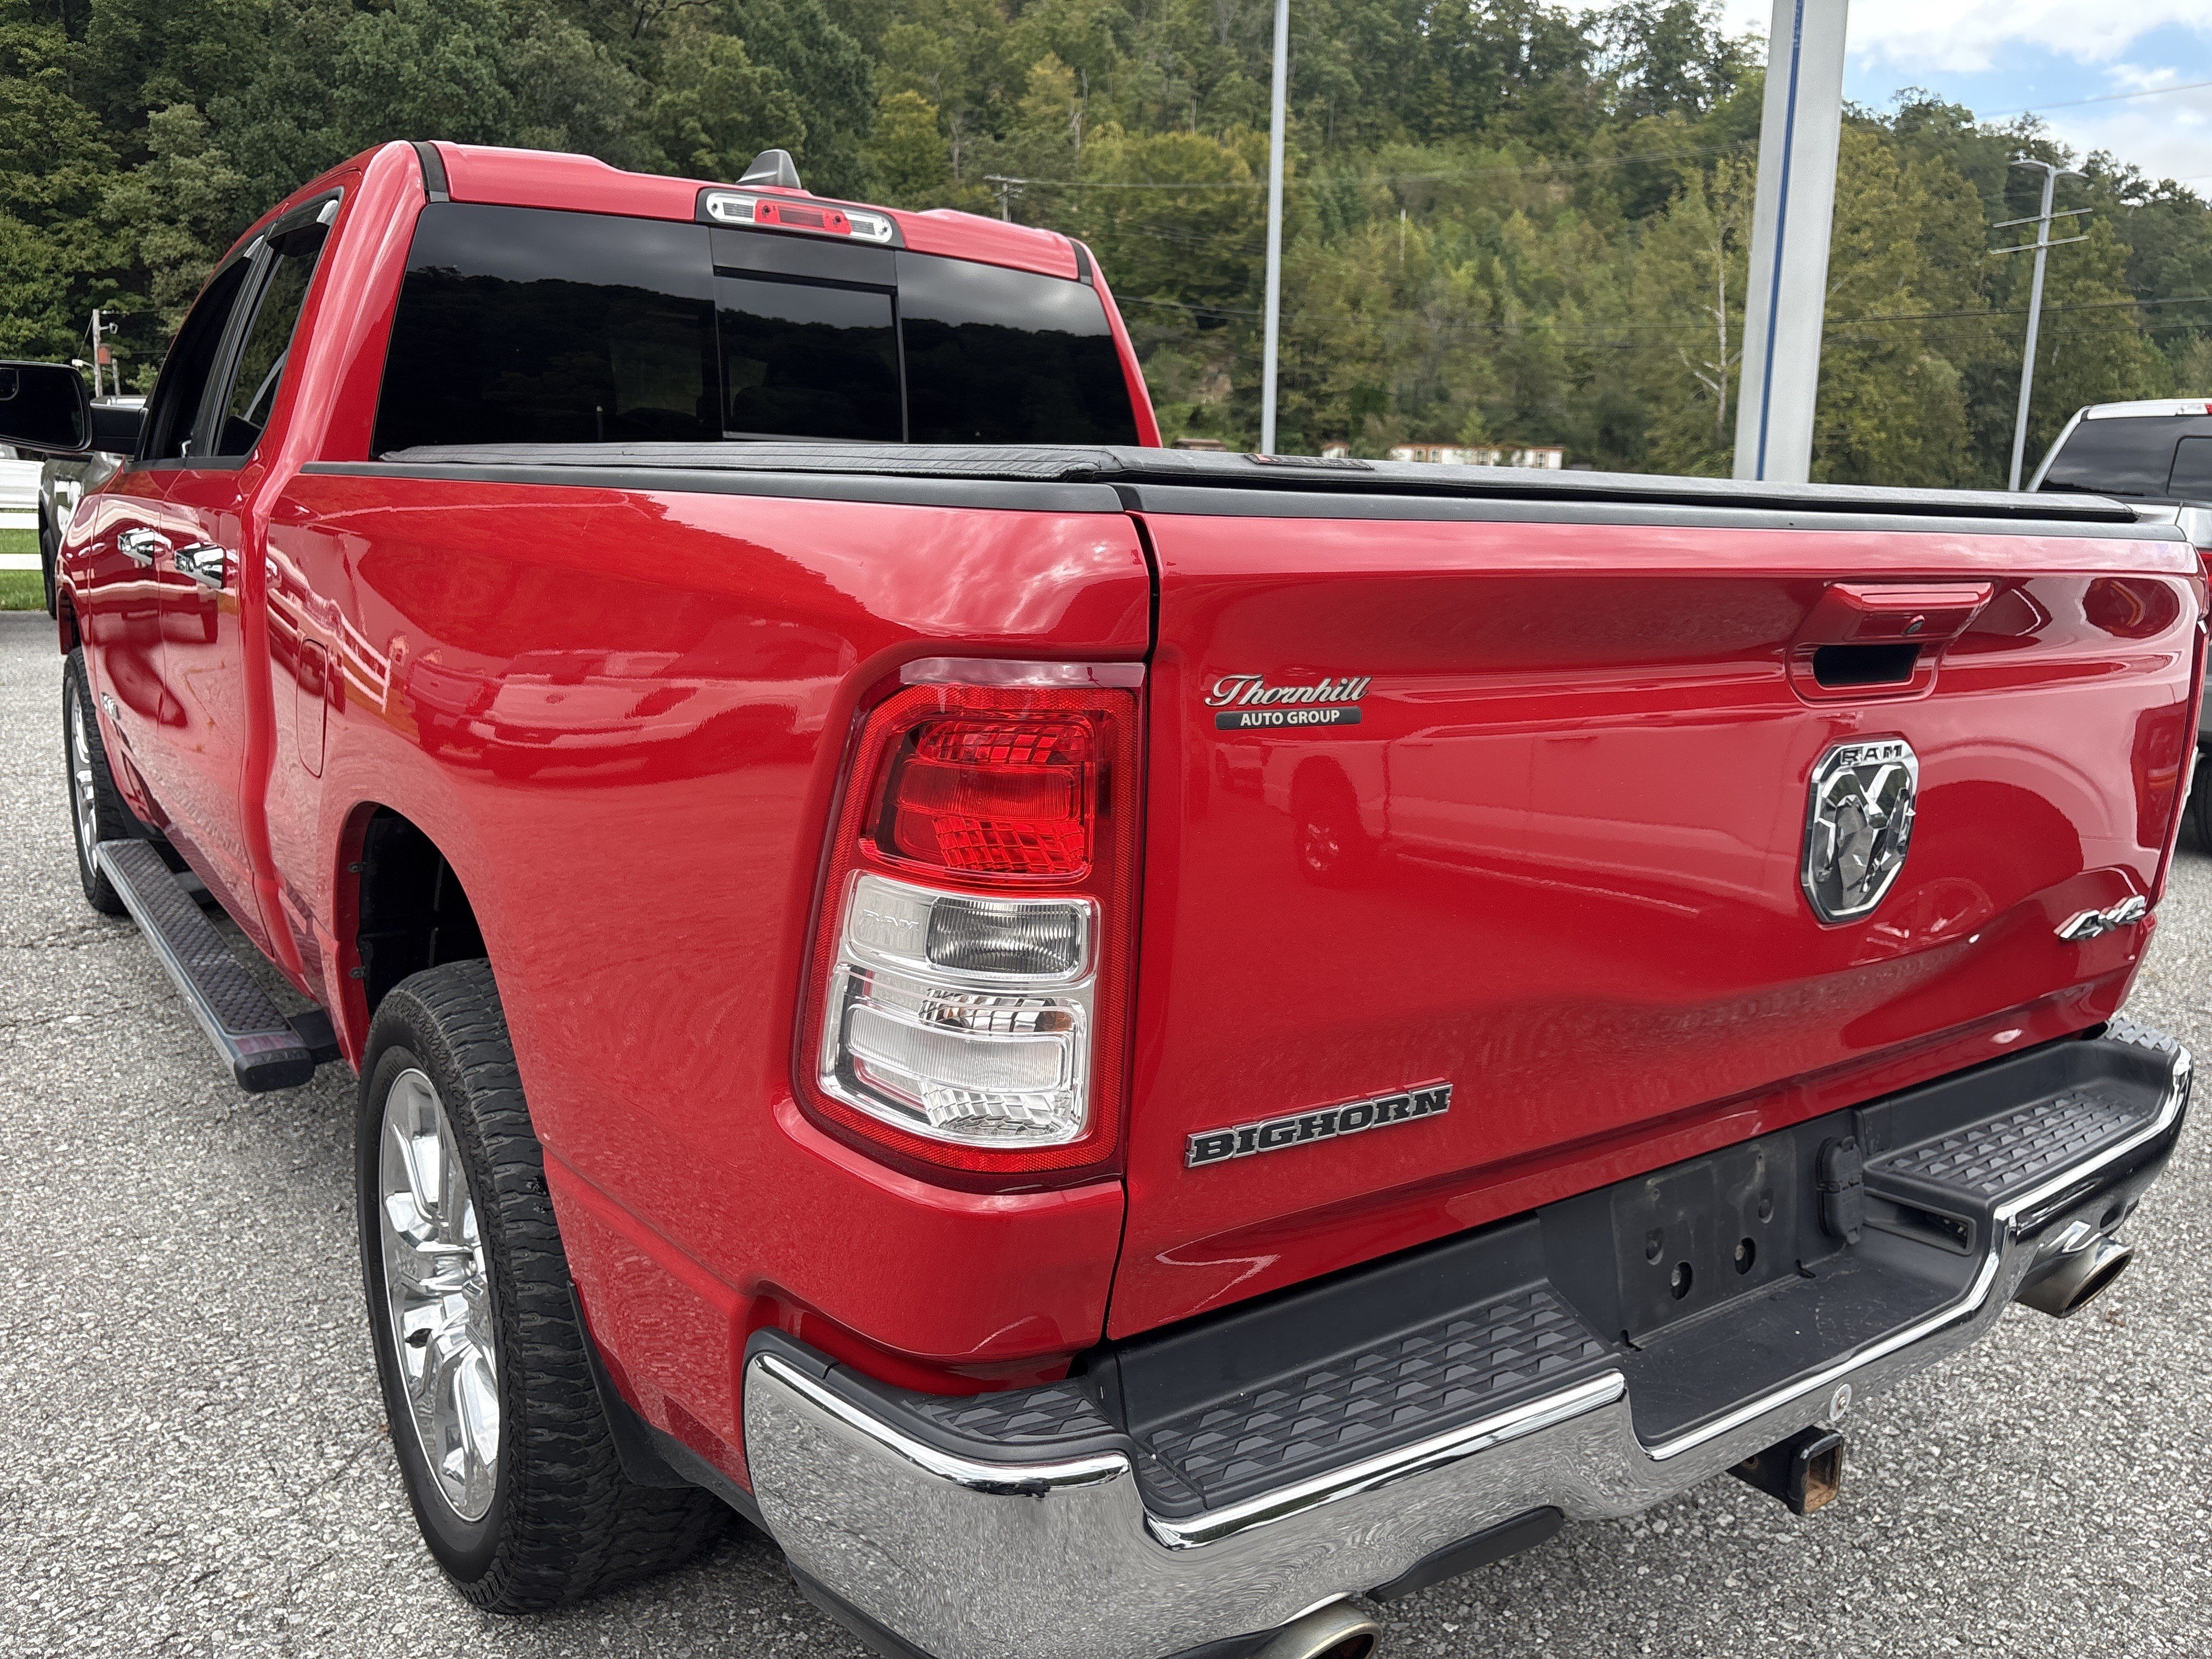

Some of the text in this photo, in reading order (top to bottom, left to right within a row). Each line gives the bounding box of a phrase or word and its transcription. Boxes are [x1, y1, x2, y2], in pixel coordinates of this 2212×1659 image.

[1205, 674, 1373, 707] Thornhill
[1240, 709, 1341, 727] AUTO GROUP
[1840, 743, 1904, 765] RAM
[1185, 1083, 1454, 1169] BIGHORN
